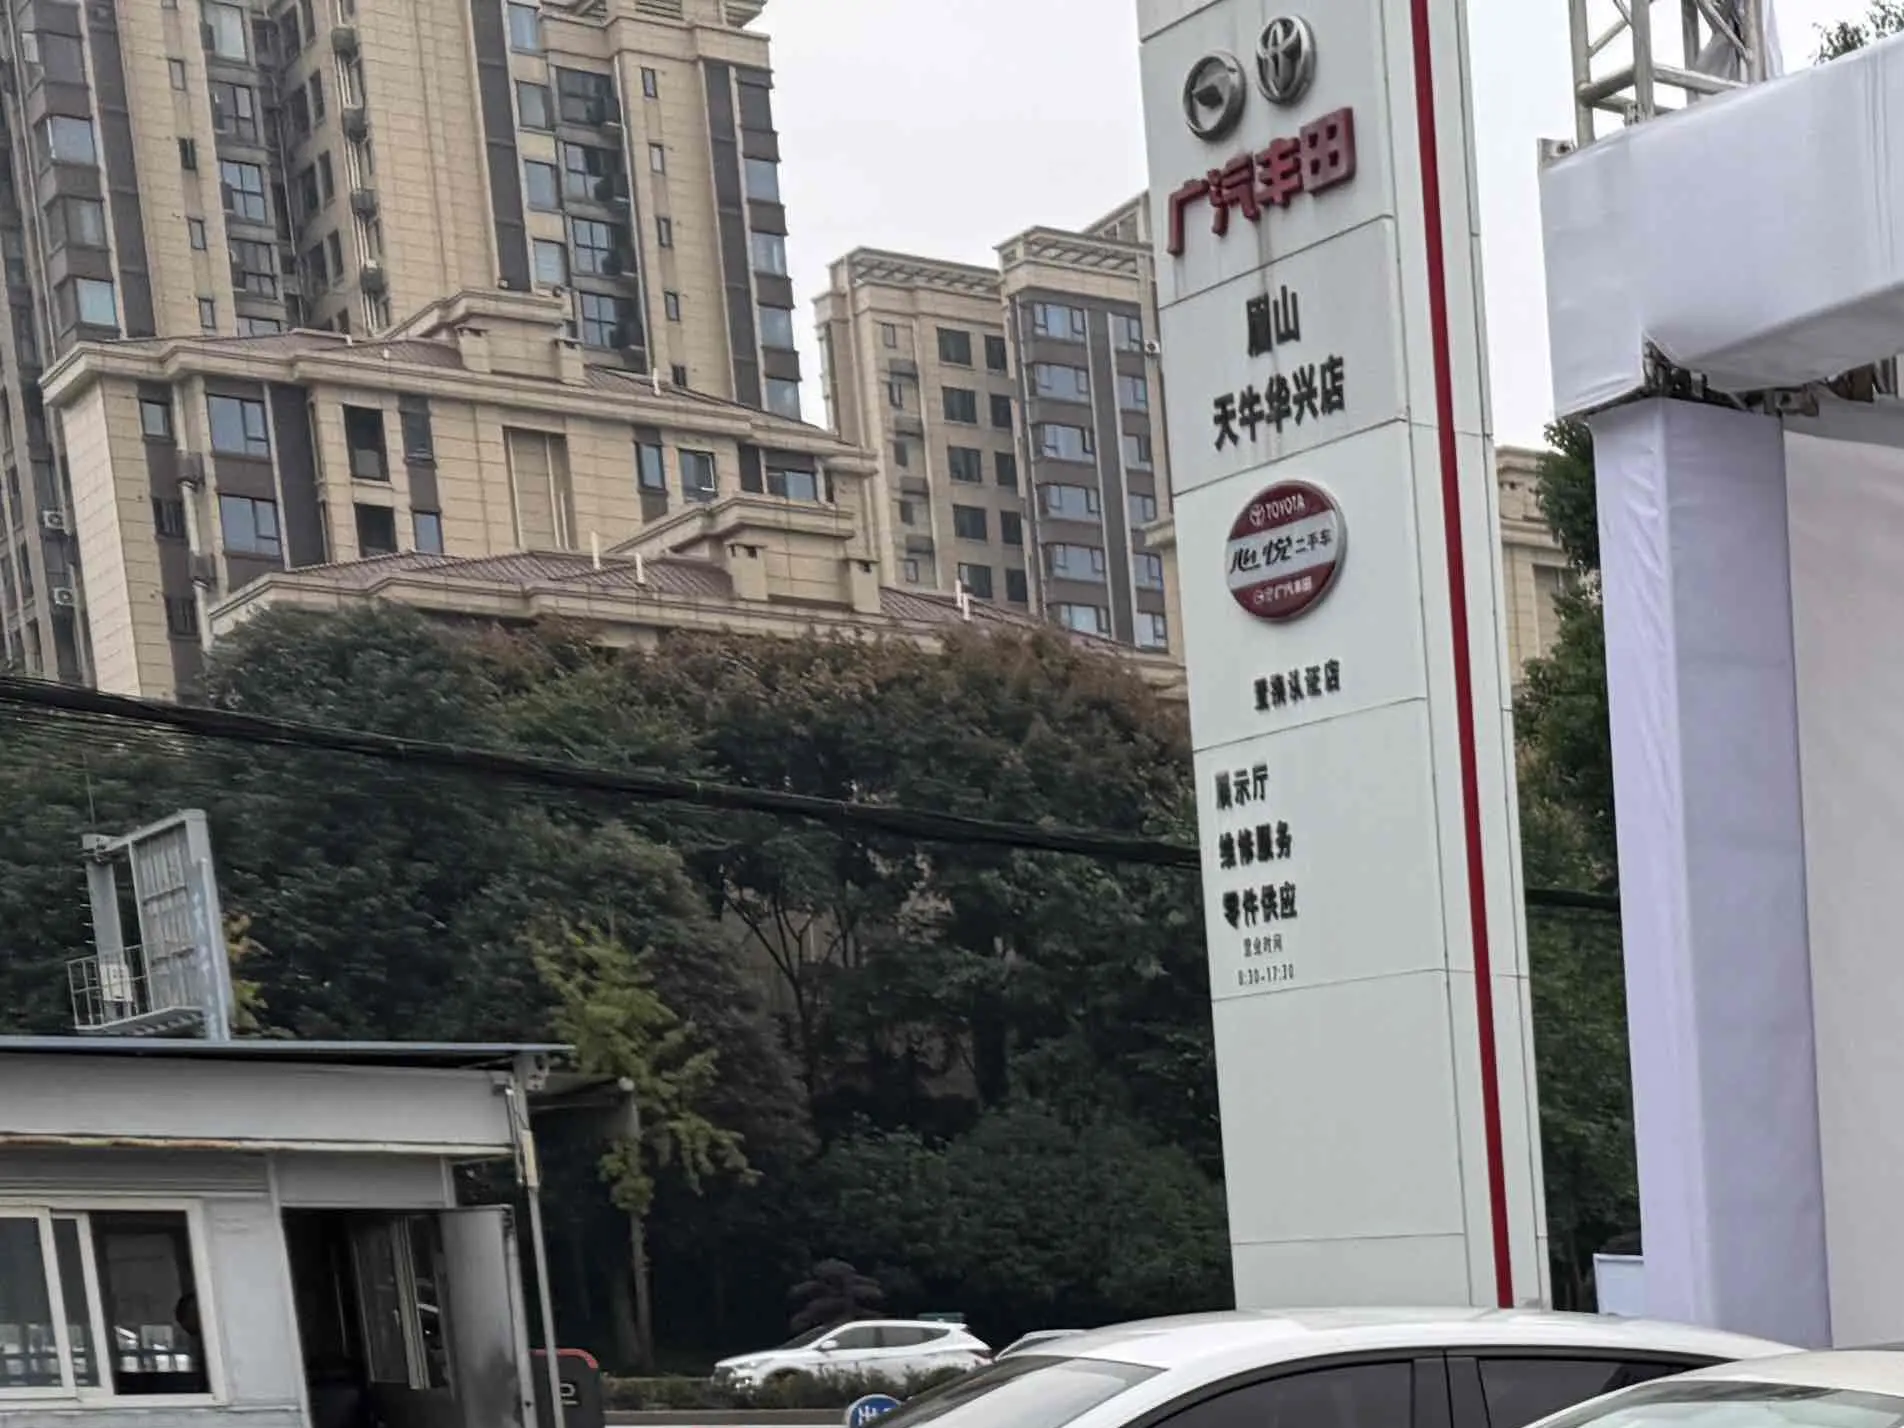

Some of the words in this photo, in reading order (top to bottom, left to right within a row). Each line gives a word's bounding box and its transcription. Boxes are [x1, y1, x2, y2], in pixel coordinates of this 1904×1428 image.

[1168, 107, 1356, 256] 广汽丰田
[1246, 284, 1300, 358] 眉山
[1213, 354, 1345, 452] 天牛华兴店
